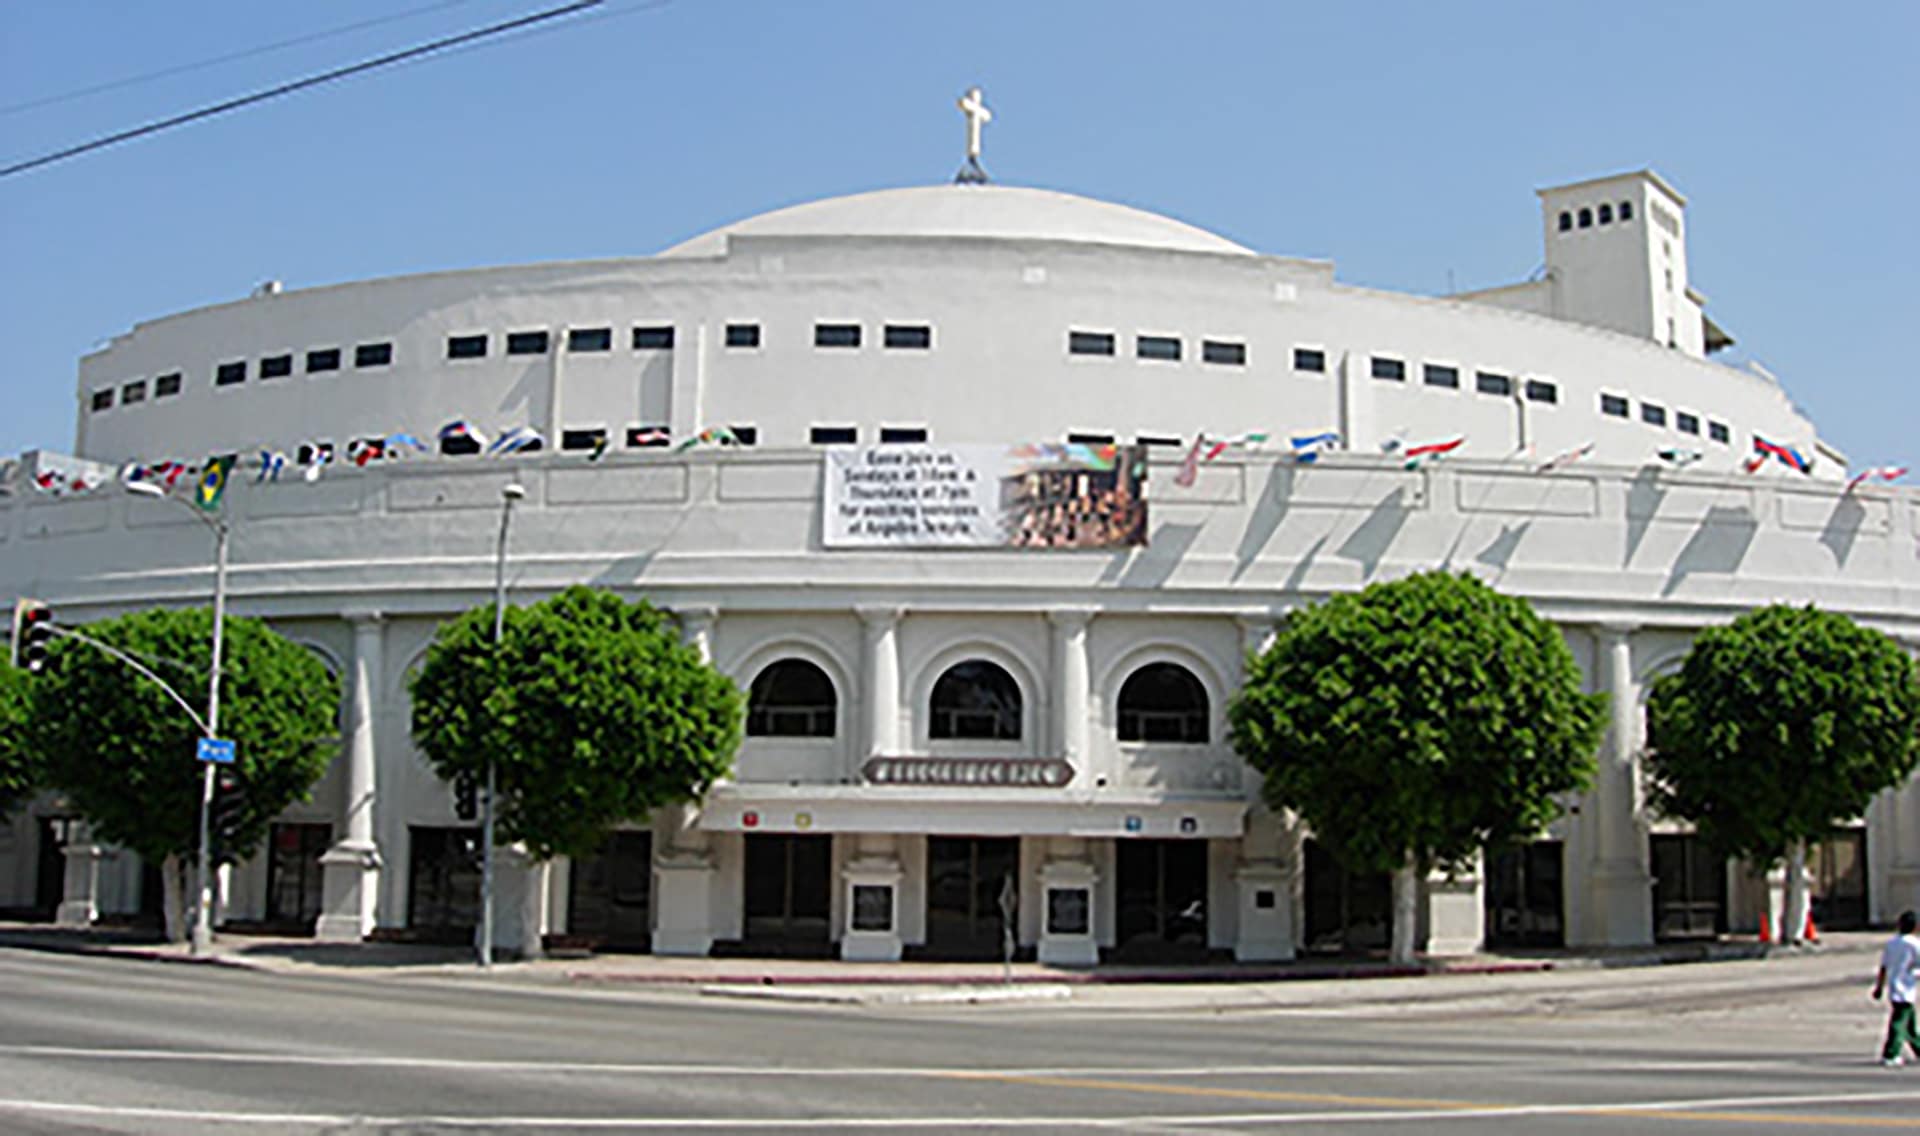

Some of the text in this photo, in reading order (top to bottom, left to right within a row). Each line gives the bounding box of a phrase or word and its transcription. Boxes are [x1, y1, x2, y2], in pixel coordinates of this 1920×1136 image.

[844, 468, 899, 484] Sundays
[905, 469, 917, 481] at
[850, 485, 918, 500] Thursdays
[923, 486, 937, 498] at
